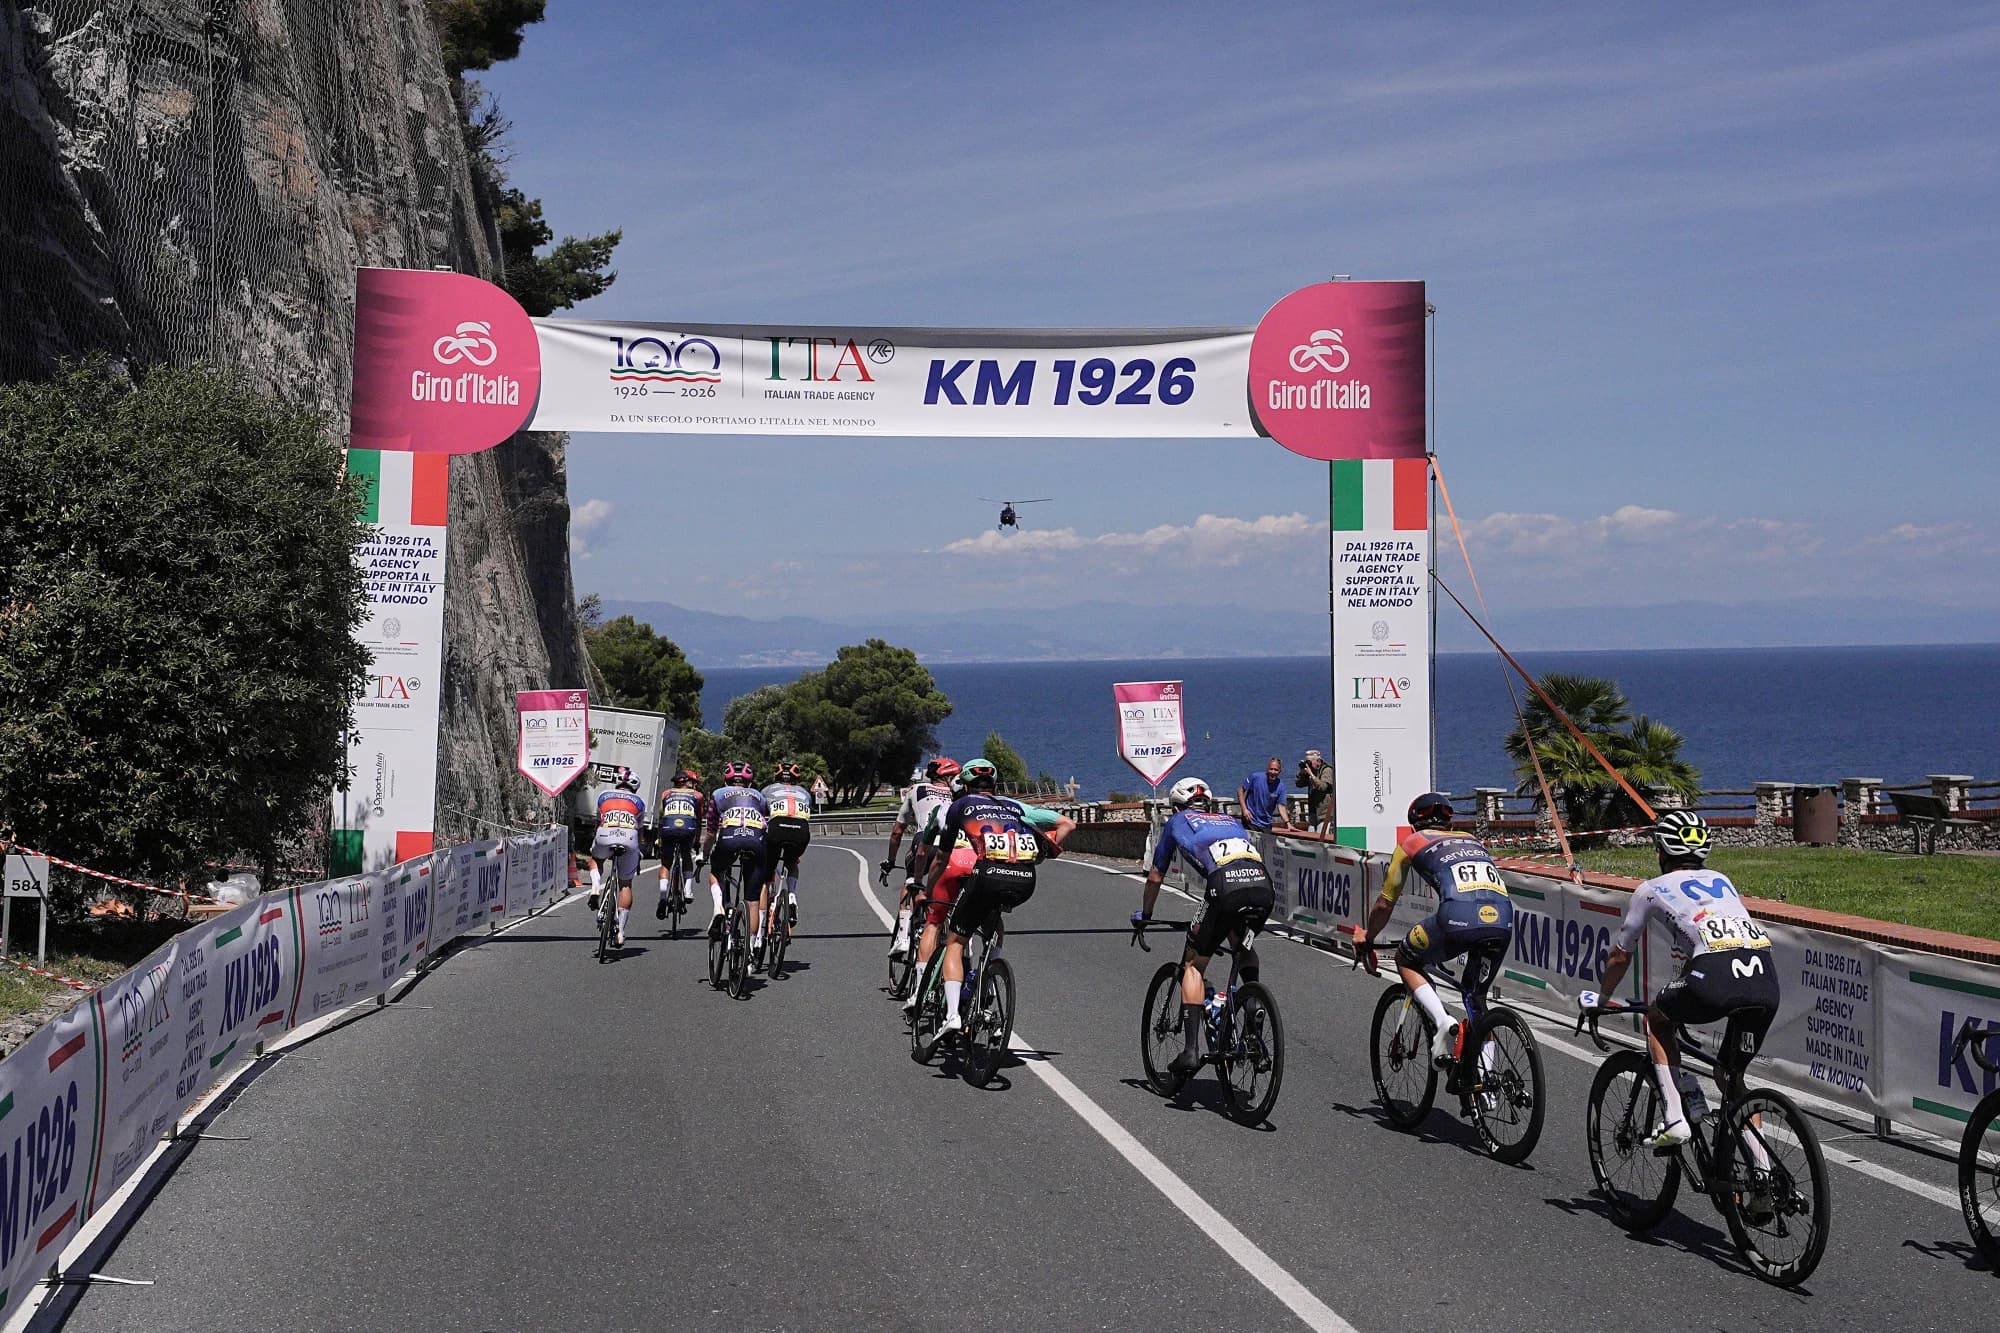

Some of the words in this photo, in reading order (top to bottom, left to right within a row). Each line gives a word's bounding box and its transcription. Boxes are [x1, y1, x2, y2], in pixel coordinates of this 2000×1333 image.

[764, 336, 875, 382] ITA
[411, 370, 452, 402] Giro
[456, 372, 520, 406] d'Italia
[923, 359, 1036, 405] KM
[1052, 357, 1197, 406] 1926
[614, 384, 648, 400] 1926
[680, 384, 716, 398] 2026
[764, 390, 801, 400] ITALIAN
[803, 390, 834, 401] TRADE
[837, 391, 875, 401] AGENCY
[1268, 380, 1306, 410] Giro
[1310, 379, 1371, 409] d'Italia
[610, 414, 625, 423] DA
[628, 414, 644, 423] UN
[647, 415, 693, 424] SECOLO
[696, 416, 756, 425] PORTIAMO
[759, 417, 805, 426] L'ITALIA
[808, 418, 829, 426] NEL
[832, 418, 876, 427] MONDO
[384, 535, 410, 546] 1926
[412, 537, 431, 547] ITA
[1346, 542, 1367, 551] DAL
[1370, 541, 1394, 551] 1926
[1396, 541, 1414, 551] ITA
[353, 546, 398, 557] TALIAN
[401, 548, 439, 559] TRADE
[1339, 553, 1382, 563] ITALIAN
[1385, 552, 1421, 562] TRADE
[369, 559, 420, 569] AGENCY
[1356, 564, 1404, 574] AGENCY
[364, 570, 419, 581] UPPORTA
[422, 572, 431, 582] IL
[1345, 575, 1403, 585] SUPPORTA
[1406, 575, 1415, 585] IL
[388, 582, 401, 592] IN
[403, 583, 436, 593] ITALY
[1340, 587, 1374, 597] MADE
[1375, 587, 1388, 596] IN
[1389, 586, 1420, 596] ITALY
[381, 594, 428, 605] MONDO
[1347, 598, 1367, 608] NEL
[1369, 598, 1413, 608] MONDO
[1351, 677, 1401, 700] ITA
[1134, 747, 1149, 756] KM
[1151, 746, 1172, 755] 1926
[533, 757, 550, 767] KM
[551, 756, 574, 766] 1926
[773, 801, 785, 811] 96
[798, 802, 809, 814] 96
[620, 812, 634, 826] 205
[989, 834, 1006, 850] 35
[1018, 836, 1036, 851] 35
[1219, 842, 1231, 857] 2
[1458, 865, 1477, 882] 67
[11, 879, 41, 892] 584
[1298, 867, 1320, 910] KM
[1322, 870, 1351, 918] 1926
[1707, 918, 1735, 939] 84
[1514, 910, 1550, 970] KM
[1805, 949, 1823, 968] DAL
[1825, 953, 1845, 971] 1926
[1847, 958, 1862, 977] ITA
[1801, 970, 1836, 993] ITALIAN
[1838, 978, 1869, 1002] TRADE
[219, 953, 250, 1036] KM
[1815, 996, 1854, 1021] AGENCY
[1807, 1016, 1855, 1042] SUPPORTA
[1857, 1030, 1864, 1047] IL
[1806, 1036, 1832, 1058] MADE
[1833, 1042, 1844, 1061] IN
[1844, 1045, 1869, 1072] ITALY
[1809, 1061, 1825, 1080] NEL
[1827, 1068, 1864, 1094] MONDO
[24, 1080, 78, 1241] 1926
